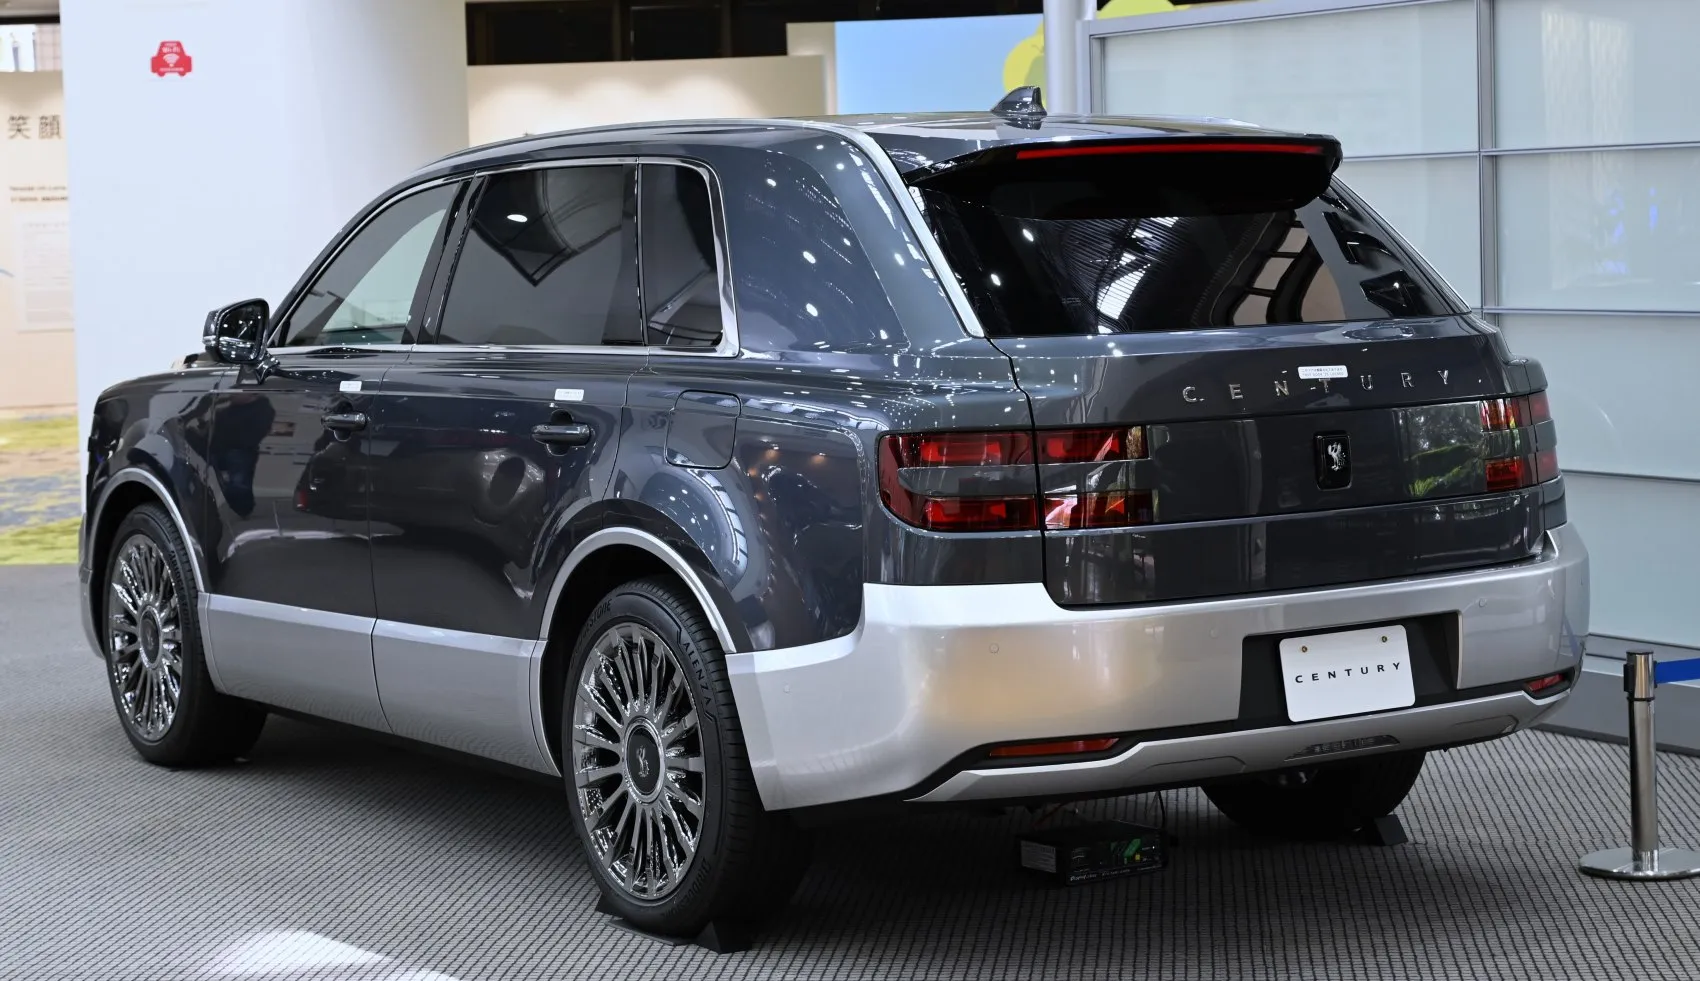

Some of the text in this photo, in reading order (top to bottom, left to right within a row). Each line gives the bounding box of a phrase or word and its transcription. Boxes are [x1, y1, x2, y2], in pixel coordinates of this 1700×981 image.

[1182, 369, 1450, 403] CENTURY
[682, 642, 712, 706] ALENZA
[1295, 662, 1400, 683] CENTURY
